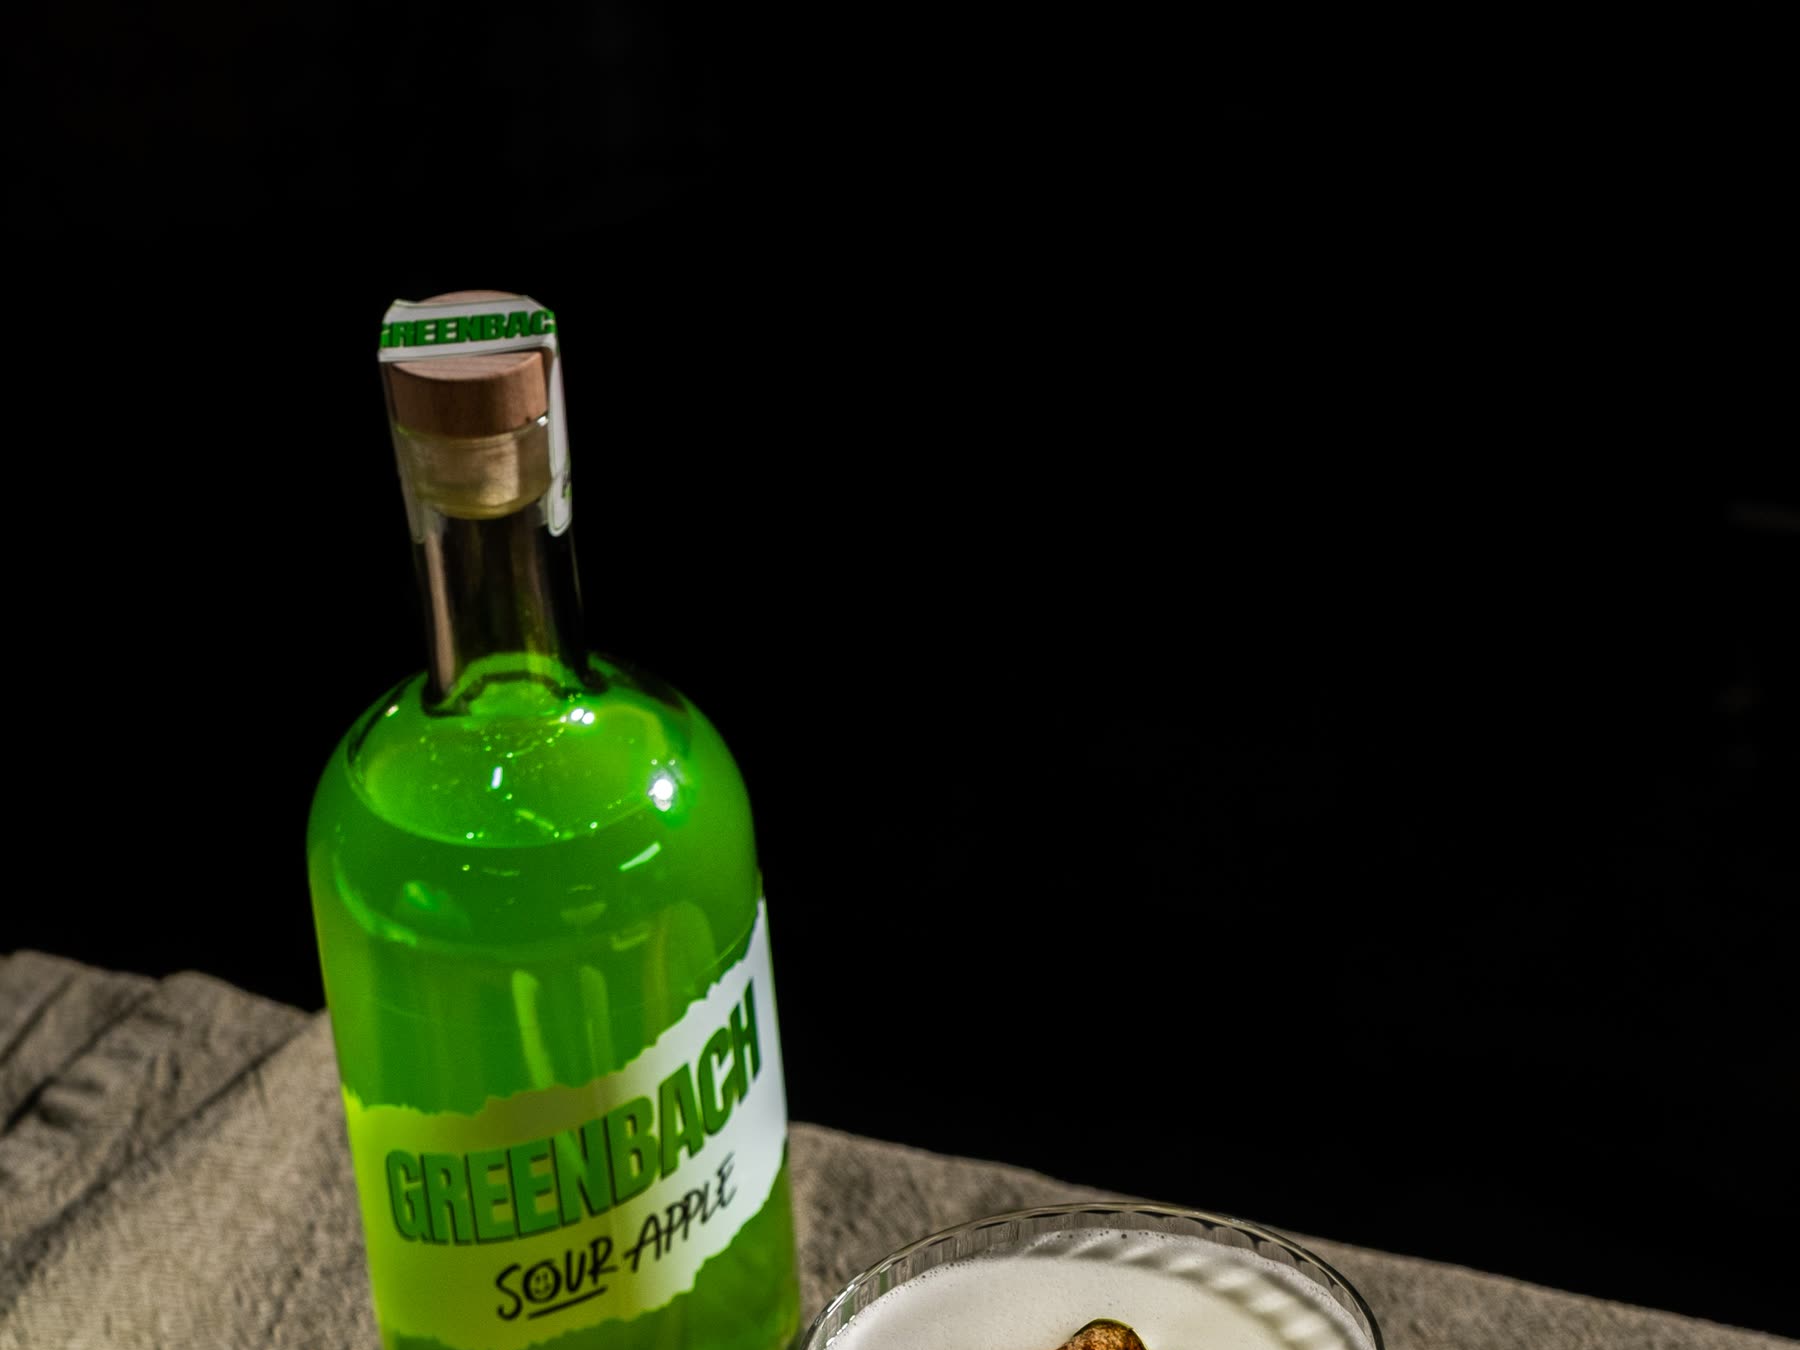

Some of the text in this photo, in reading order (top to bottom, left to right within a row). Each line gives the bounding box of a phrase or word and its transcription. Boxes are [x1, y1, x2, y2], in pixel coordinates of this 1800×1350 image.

[385, 977, 762, 1245] GREENBACH
[495, 1152, 738, 1320] SOUR APPLE
